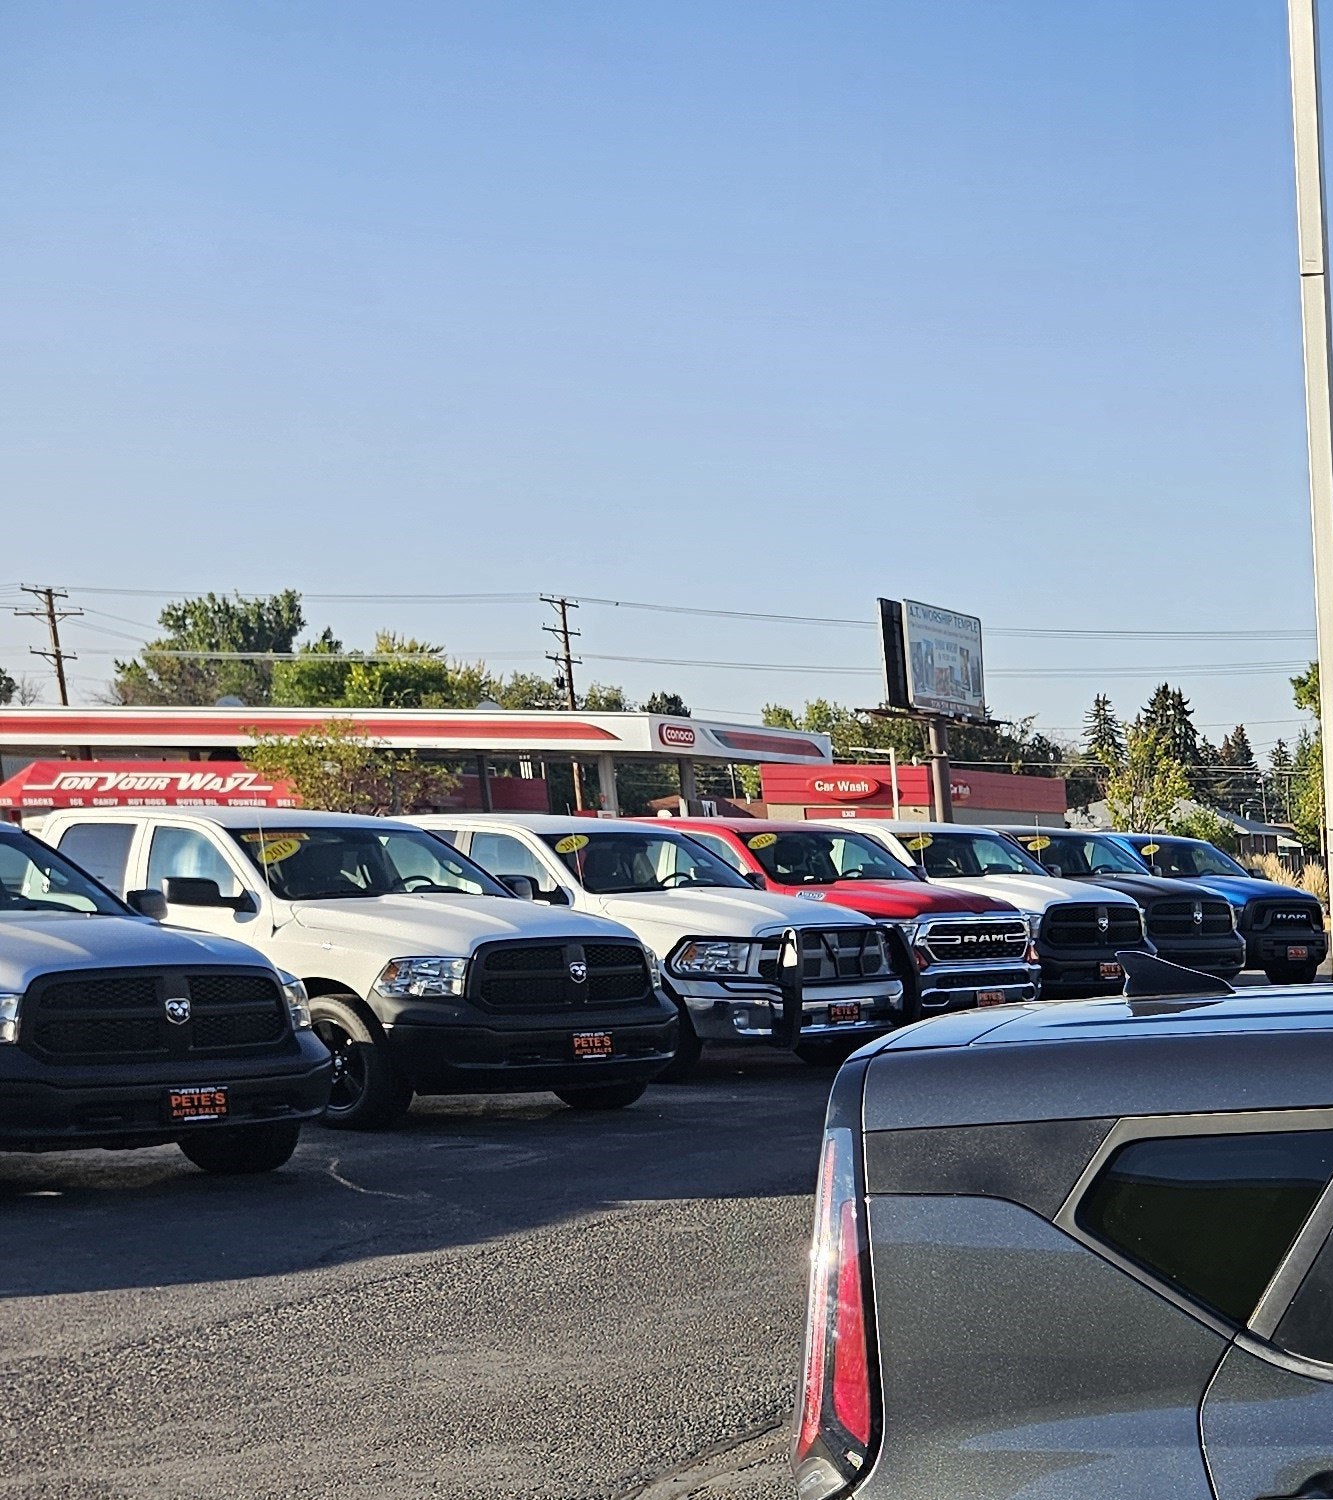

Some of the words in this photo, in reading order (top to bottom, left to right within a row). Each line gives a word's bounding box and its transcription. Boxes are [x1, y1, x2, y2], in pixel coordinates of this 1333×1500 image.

[954, 616, 978, 634] TEMPLE
[814, 780, 835, 792] Car
[836, 780, 869, 793] Wash
[963, 934, 1005, 943] RAM
[573, 1036, 612, 1048] PETE'S
[170, 1092, 226, 1108] PETE'S
[172, 1108, 197, 1117] AUTO
[198, 1106, 227, 1115] SALES
